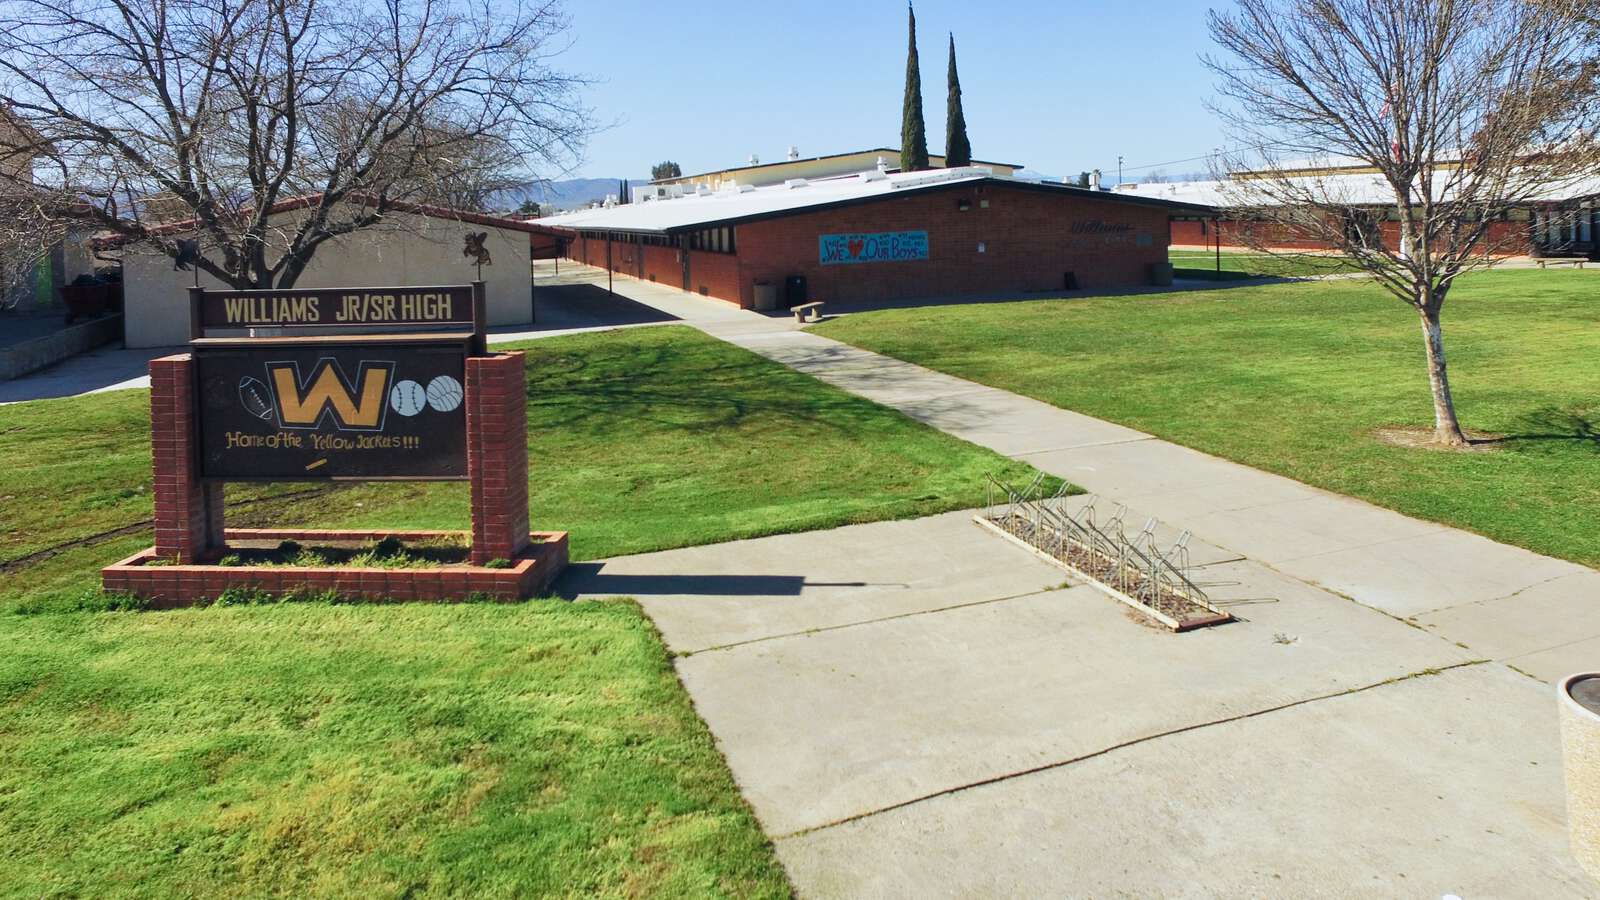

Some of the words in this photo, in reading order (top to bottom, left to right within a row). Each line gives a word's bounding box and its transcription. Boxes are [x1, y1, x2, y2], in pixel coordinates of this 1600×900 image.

[224, 297, 320, 323] WILLIAMS
[336, 294, 396, 322] JR/SR
[401, 293, 453, 320] HIGH
[267, 358, 394, 430] W
[225, 431, 264, 449] Home
[309, 433, 355, 450] Yellow
